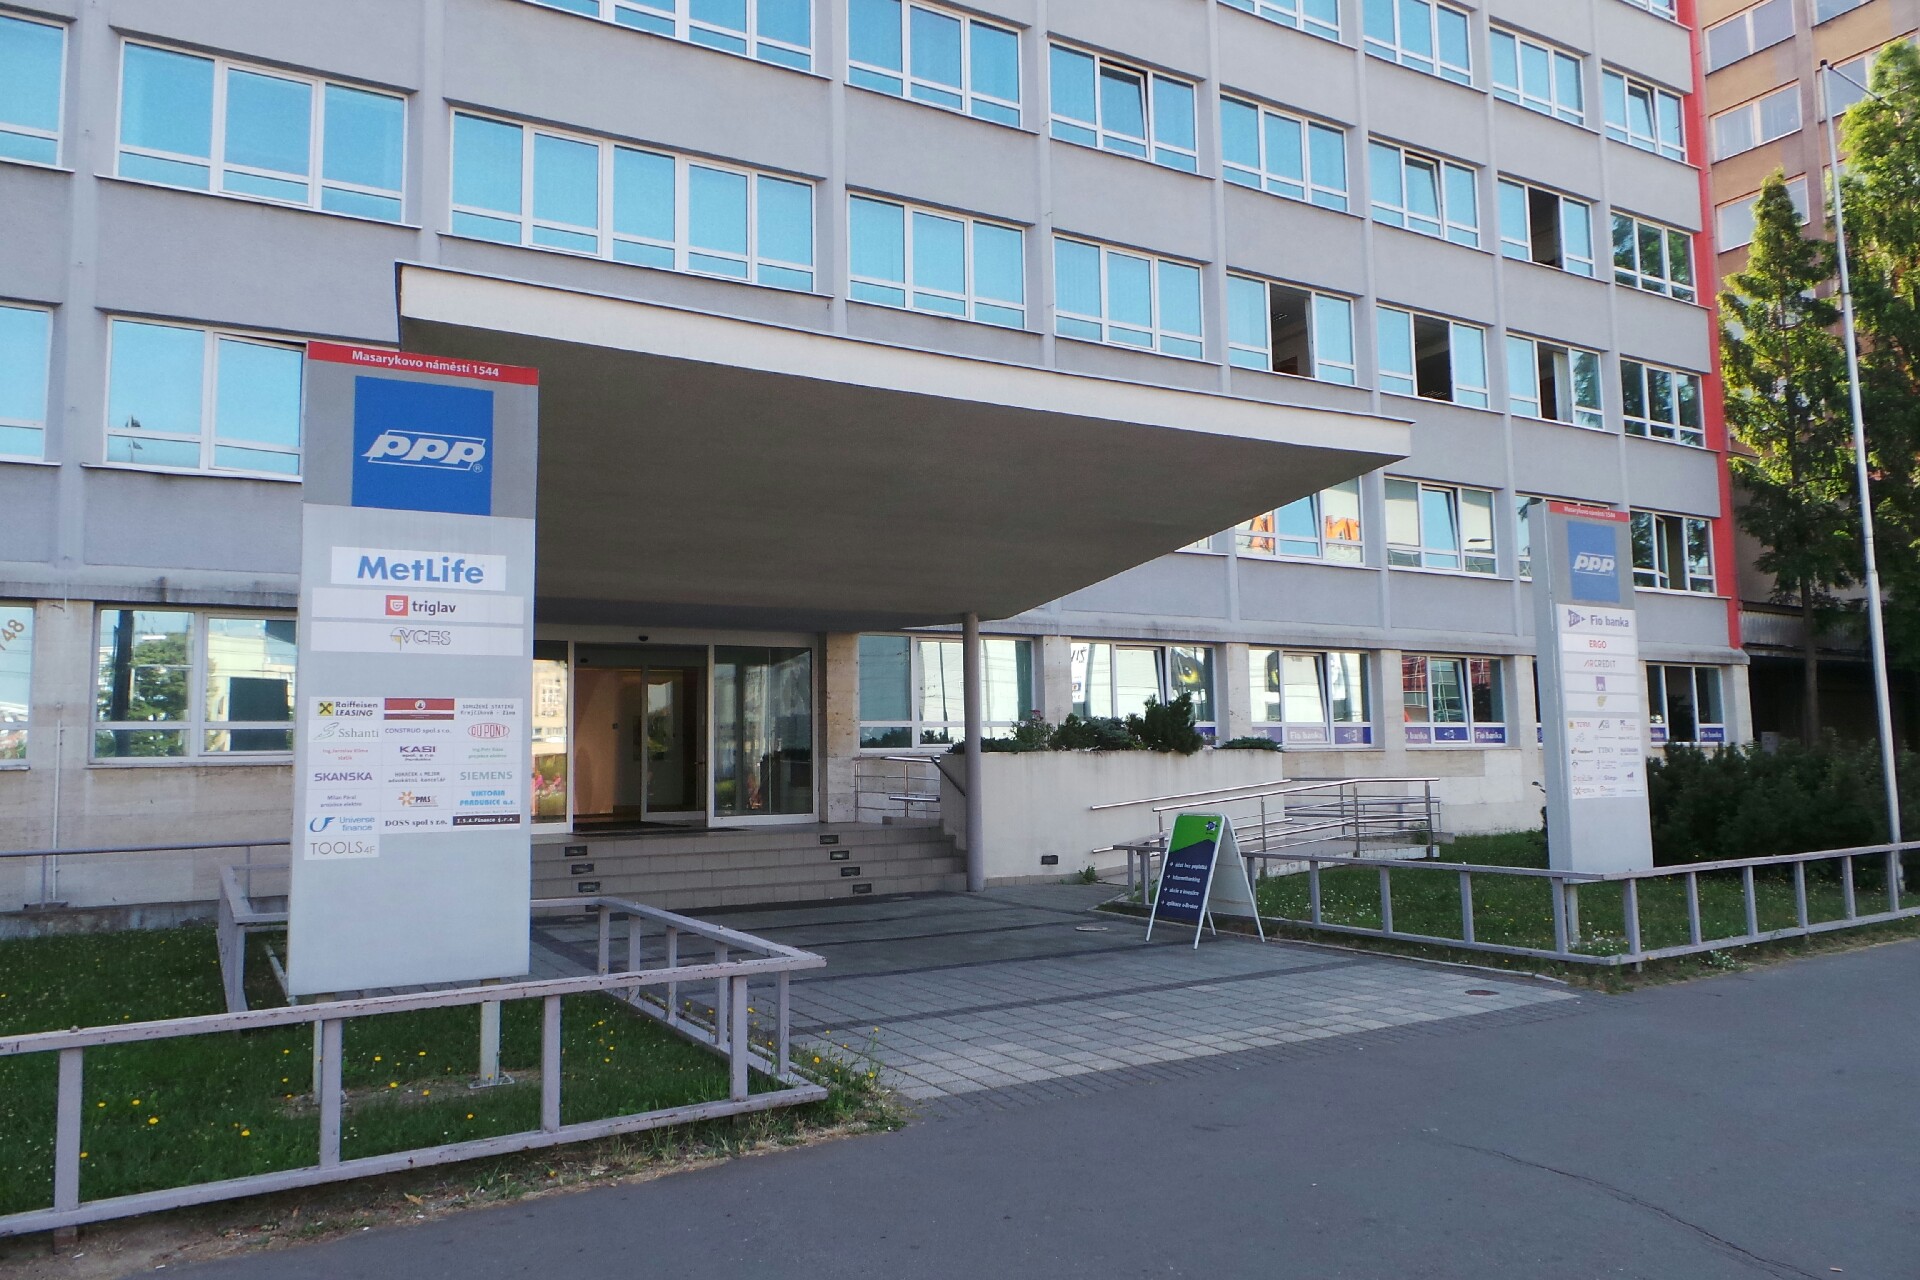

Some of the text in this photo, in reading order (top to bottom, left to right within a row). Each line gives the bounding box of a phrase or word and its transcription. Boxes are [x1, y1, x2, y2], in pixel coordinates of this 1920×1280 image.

[352, 350, 499, 377] Masarykovo náměstí 1544
[361, 432, 486, 467] ppp
[1573, 554, 1615, 573] ppp
[357, 555, 484, 584] MetLife
[412, 600, 456, 616] triglav
[1590, 614, 1603, 626] Fio
[1605, 616, 1629, 627] banka
[399, 629, 451, 645] VCES
[1589, 639, 1607, 648] ERGO
[335, 709, 373, 717] LEASING
[338, 727, 379, 738] Sshanti
[1410, 731, 1428, 740] banka
[314, 772, 373, 782] SKANSKA
[460, 771, 513, 781] SIEMENS
[342, 824, 373, 832] finance
[412, 819, 428, 827] spol
